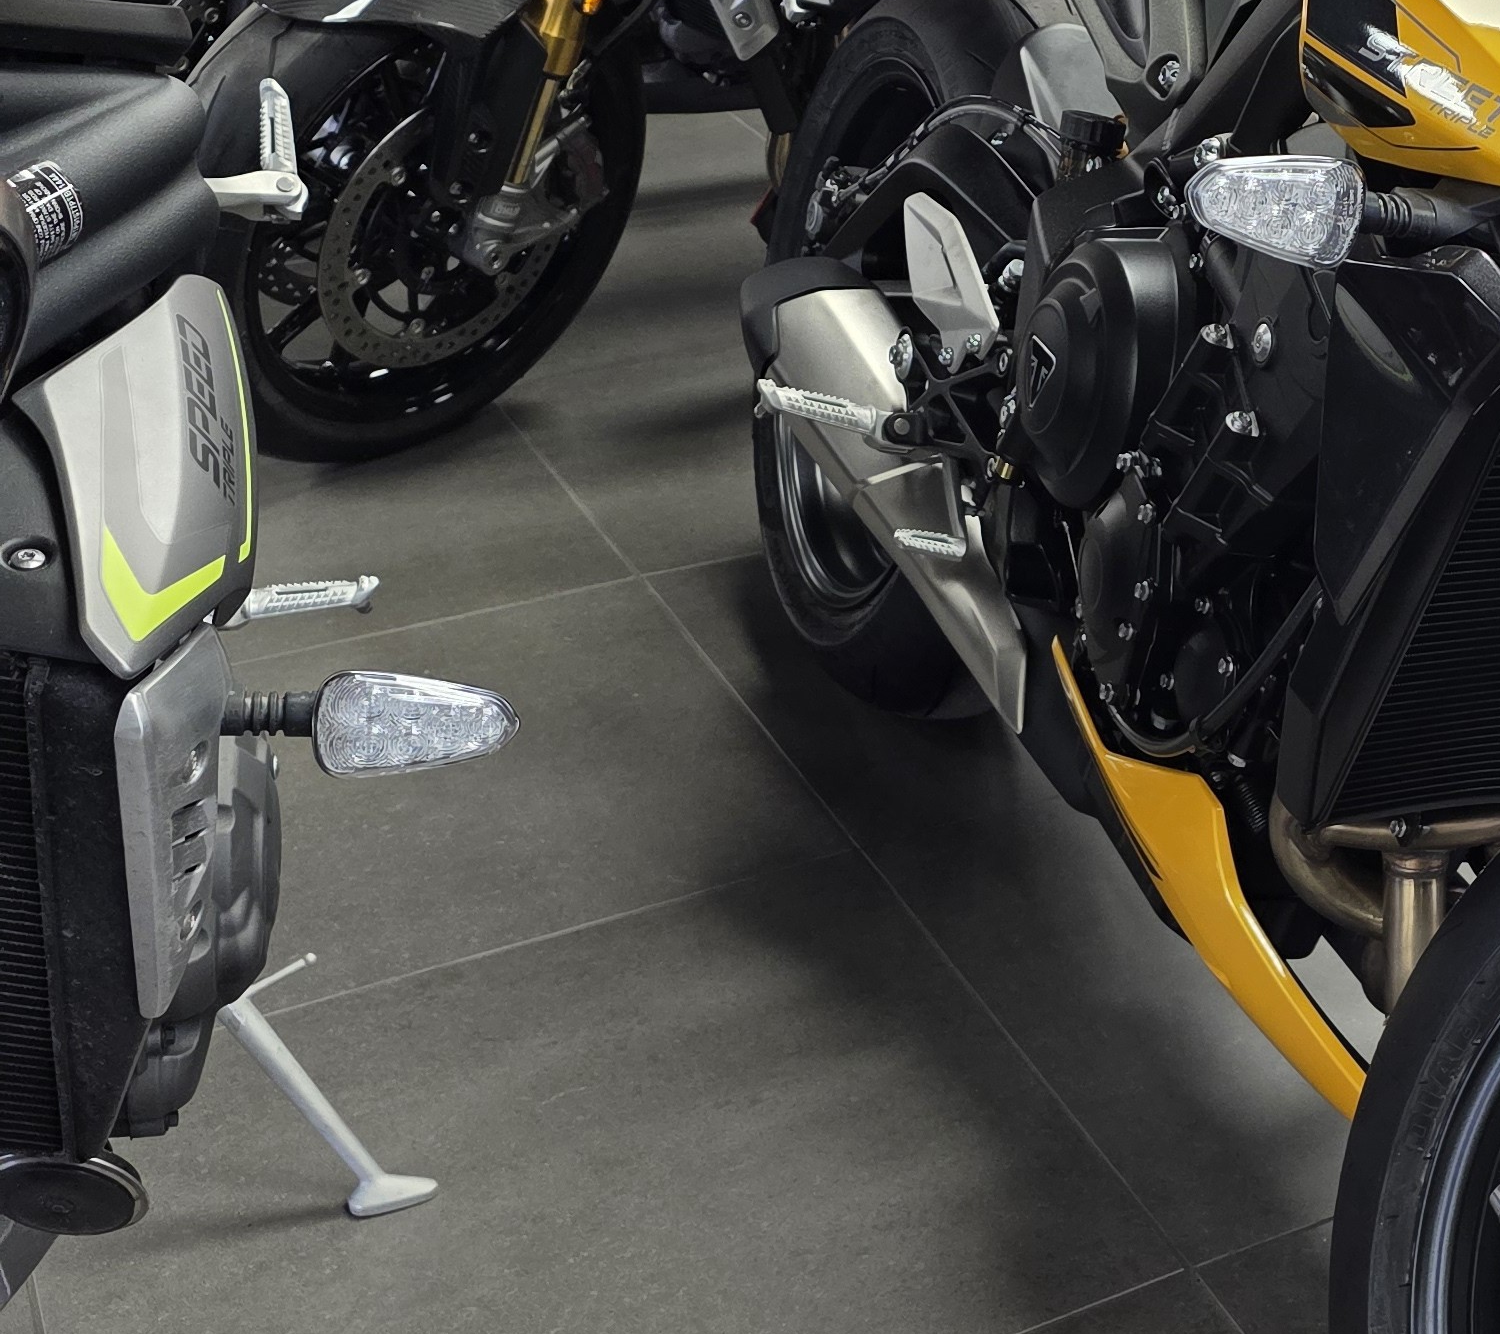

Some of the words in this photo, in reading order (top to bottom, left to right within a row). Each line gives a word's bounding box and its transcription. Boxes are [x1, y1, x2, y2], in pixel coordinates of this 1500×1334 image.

[1430, 103, 1496, 139] TRIPLE
[176, 313, 221, 489] SPEED
[219, 415, 236, 507] TRIPLE
